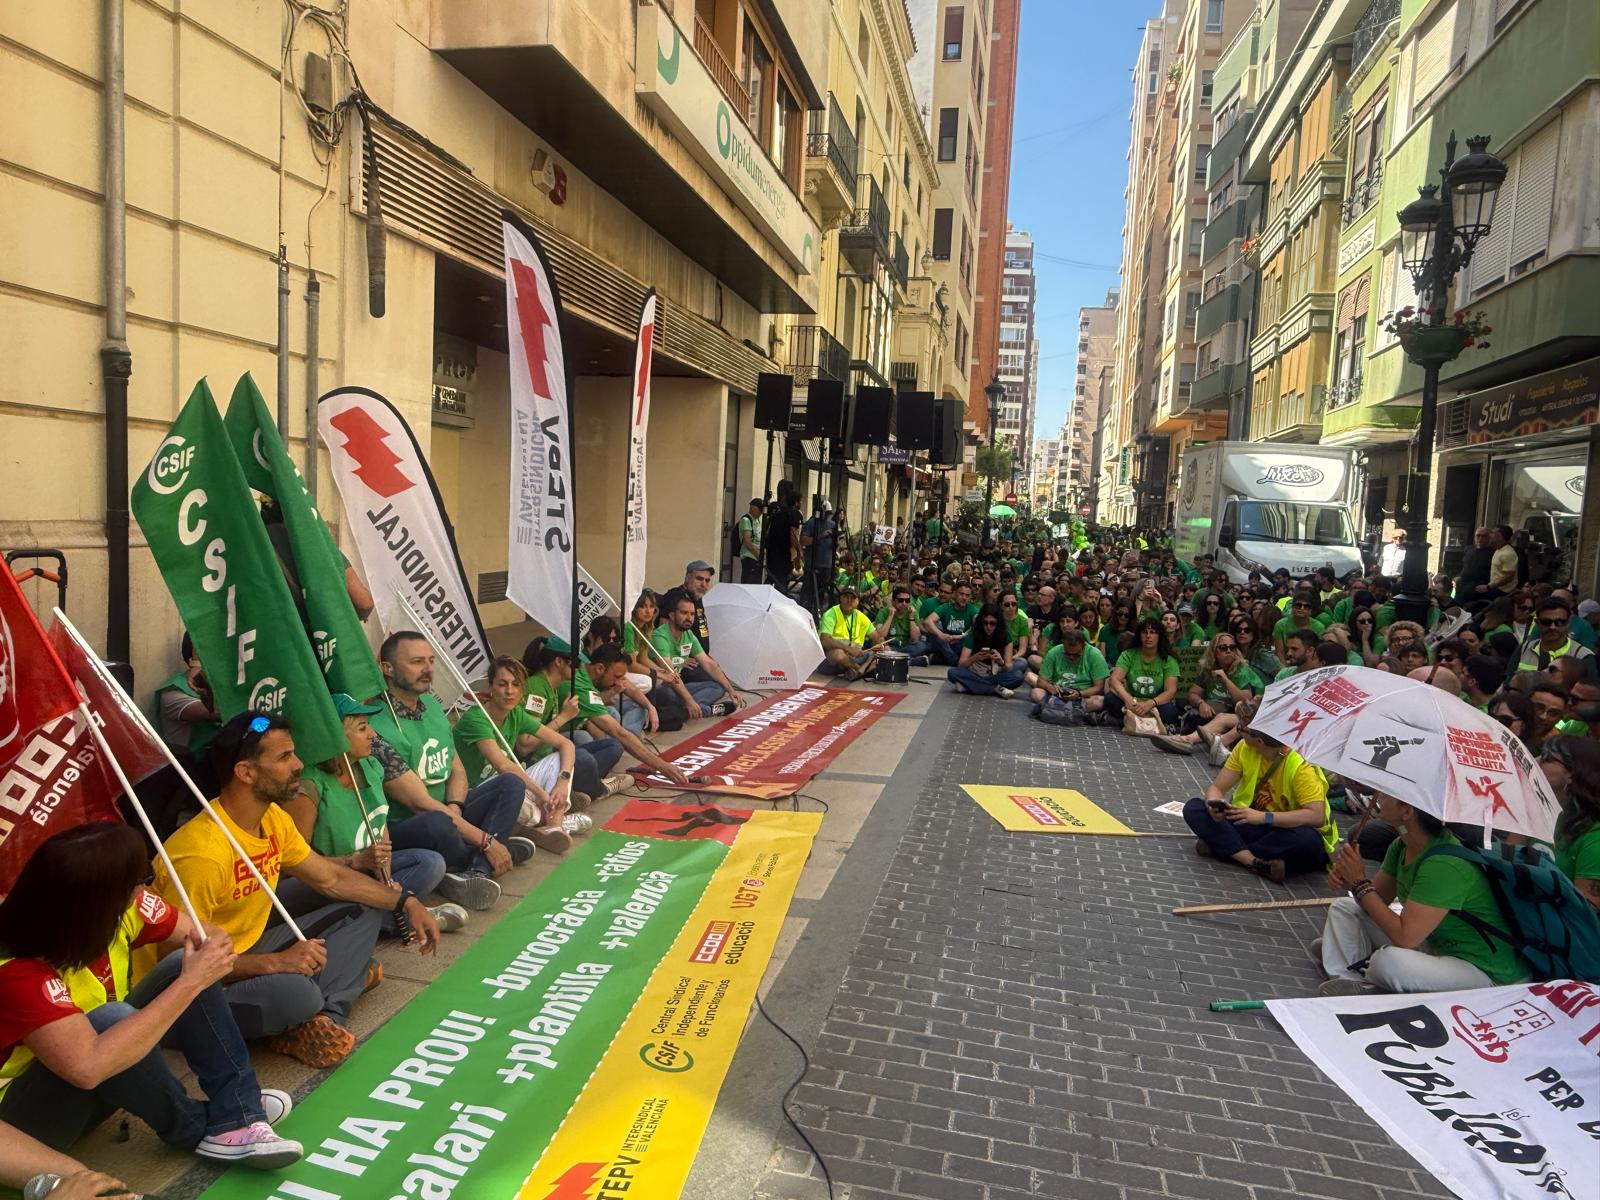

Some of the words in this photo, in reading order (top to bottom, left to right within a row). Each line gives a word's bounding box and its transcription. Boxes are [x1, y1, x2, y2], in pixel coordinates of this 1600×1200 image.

[1478, 394, 1516, 427] Studi
[155, 445, 195, 478] CSIF
[729, 886, 761, 909] UGT
[725, 921, 755, 965] educació
[496, 961, 613, 1084] +plantilla
[651, 1007, 677, 1034] Central
[666, 975, 692, 1005] Sindical
[699, 979, 731, 1026] Funcionarios
[654, 1040, 681, 1067] CSIF
[694, 1027, 710, 1038] de
[305, 1116, 406, 1177] HA
[368, 1010, 498, 1110] PROU!
[1524, 1066, 1585, 1112] PER
[620, 1097, 657, 1152] INTERSINDICAL
[638, 1098, 669, 1144] VALENCIANA
[389, 1101, 508, 1200] alari
